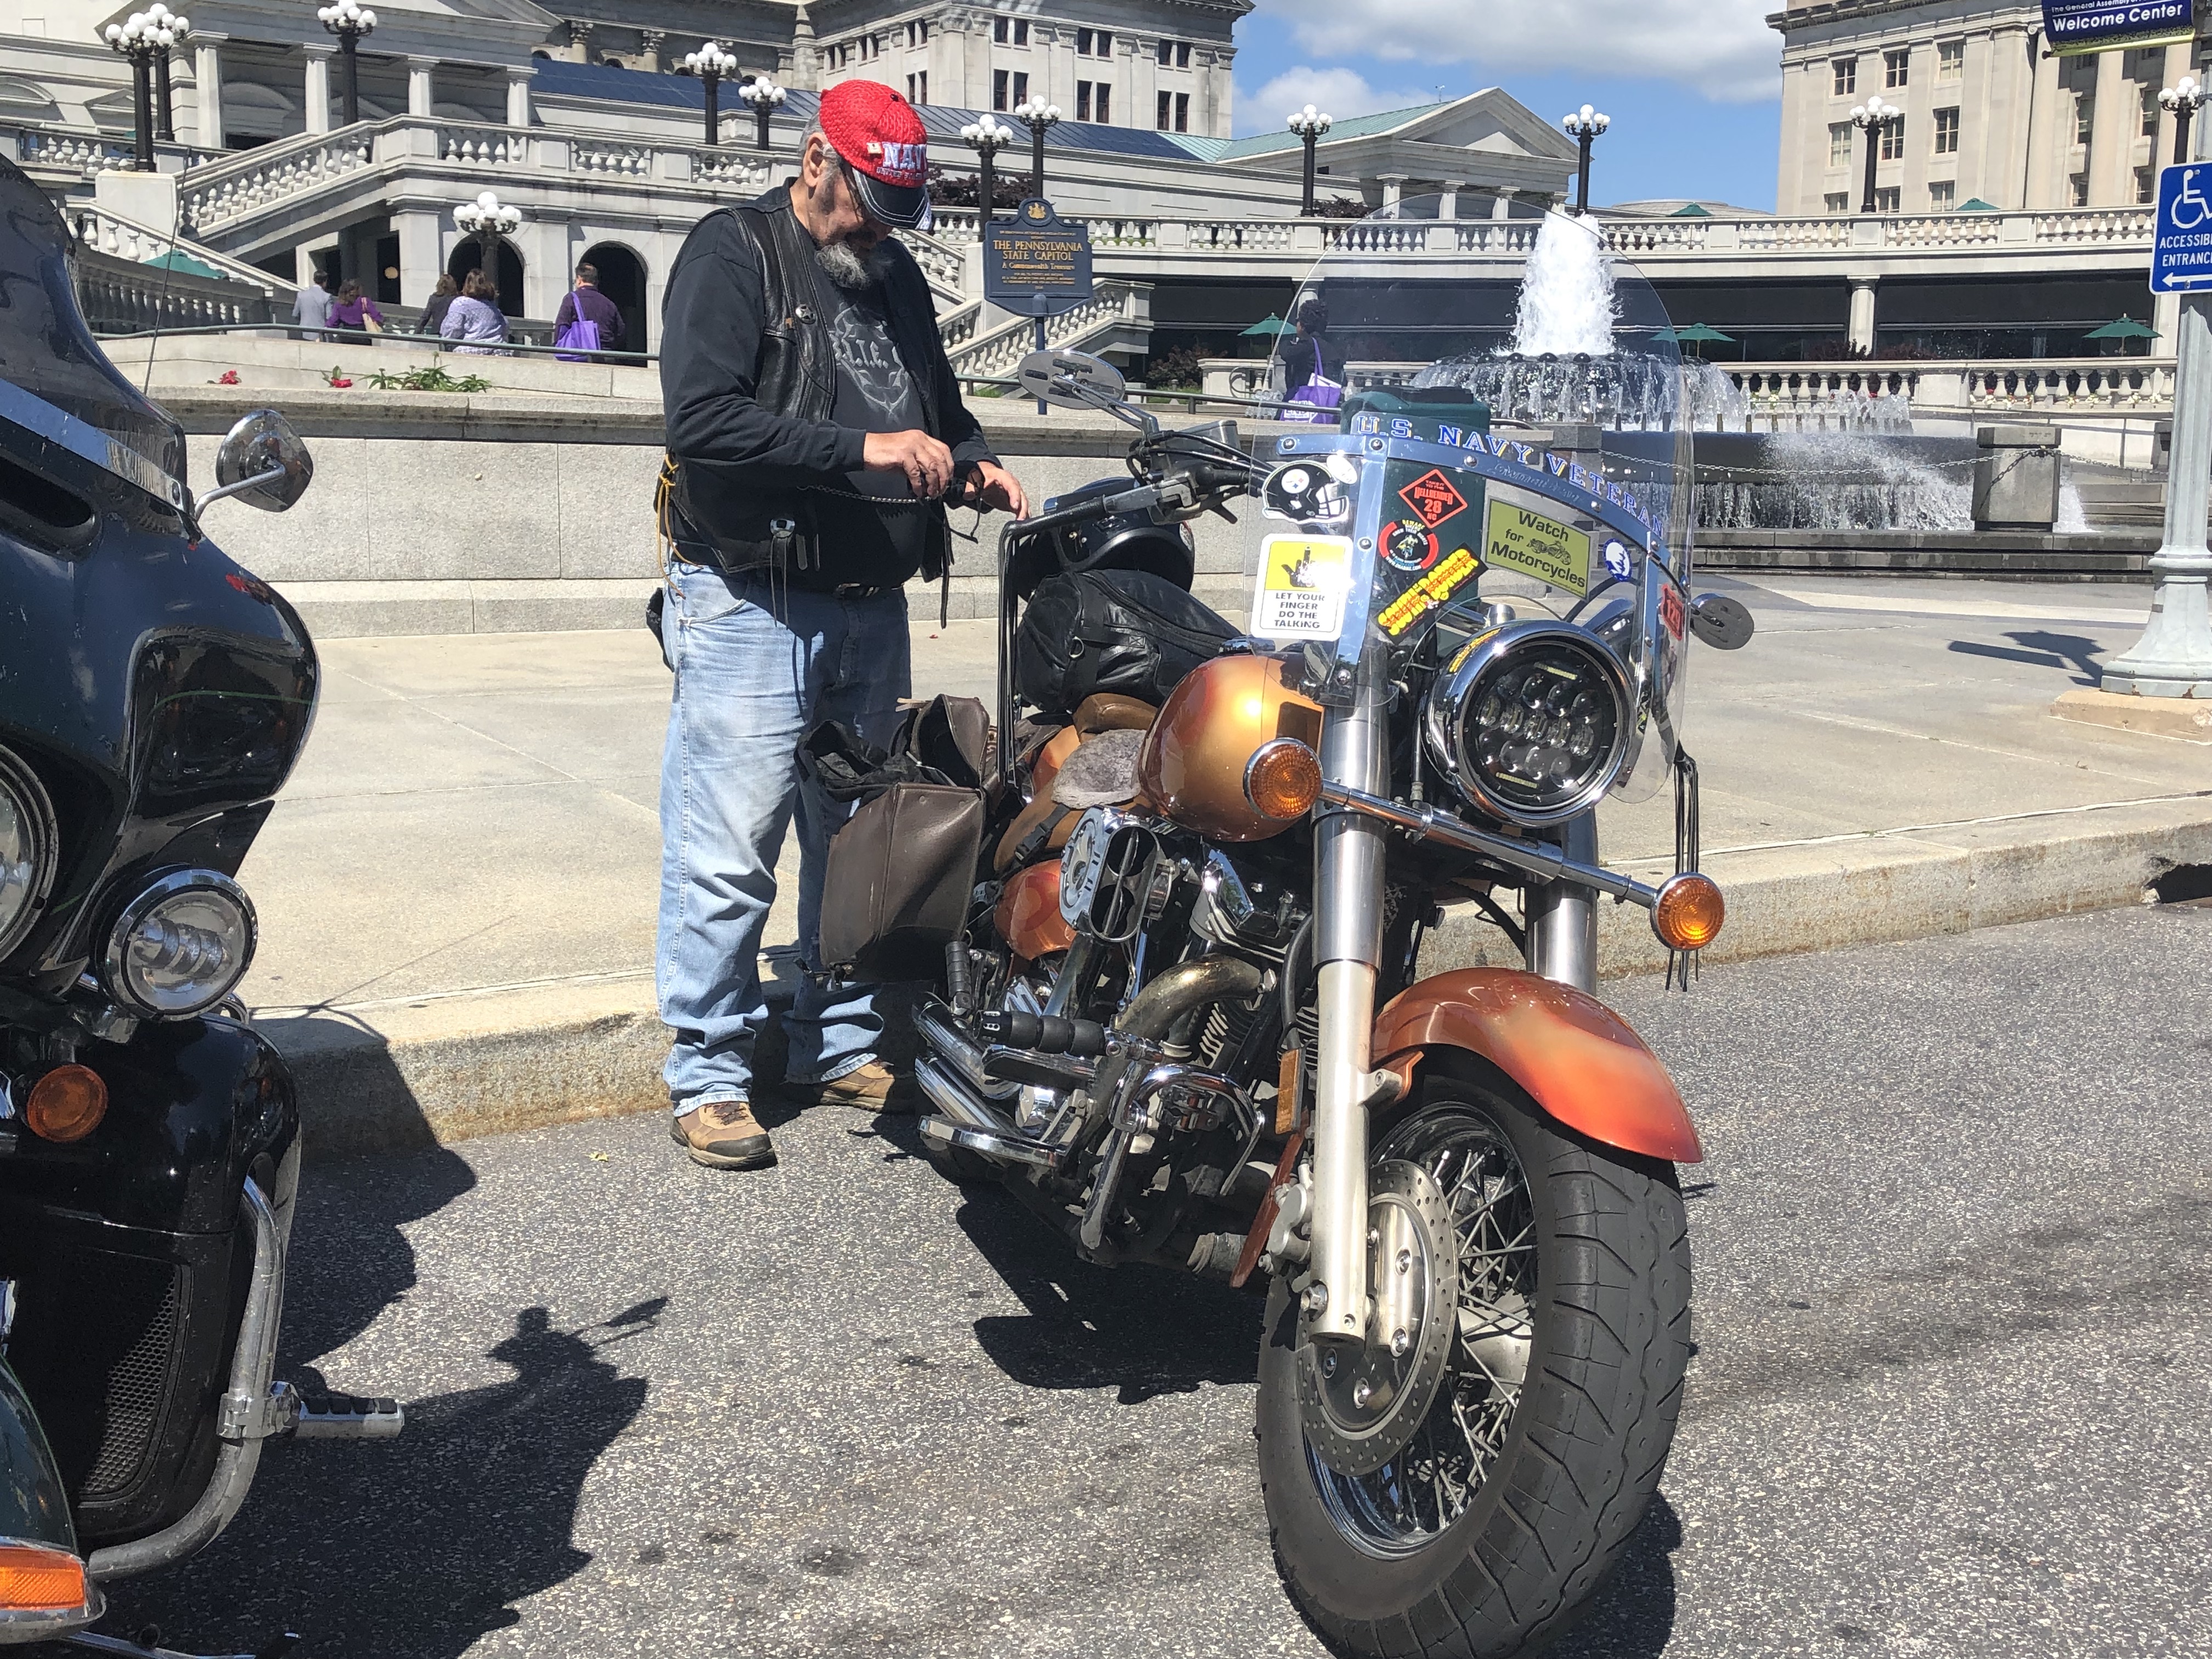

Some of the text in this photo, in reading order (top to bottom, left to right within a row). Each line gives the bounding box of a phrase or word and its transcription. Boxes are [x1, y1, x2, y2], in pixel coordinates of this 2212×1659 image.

[2066, 2, 2095, 11] General
[2053, 3, 2183, 31] Welcome Center
[993, 240, 1083, 251] THE PENNSYLVANIA
[2159, 233, 2212, 249] ACCESSIB
[1003, 251, 1074, 261] STATE CAPITOL
[2162, 251, 2212, 267] ENTRANC
[1357, 416, 1423, 441] U.S.
[1438, 425, 1534, 464] NAVY
[1546, 453, 1663, 539] VETERAN
[1424, 499, 1442, 514] 28
[1427, 512, 1437, 521] NC
[1519, 511, 1569, 541] Watch
[1505, 529, 1525, 542] for
[1491, 541, 1585, 588] Motorcycles
[1274, 619, 1321, 628] TALKING
